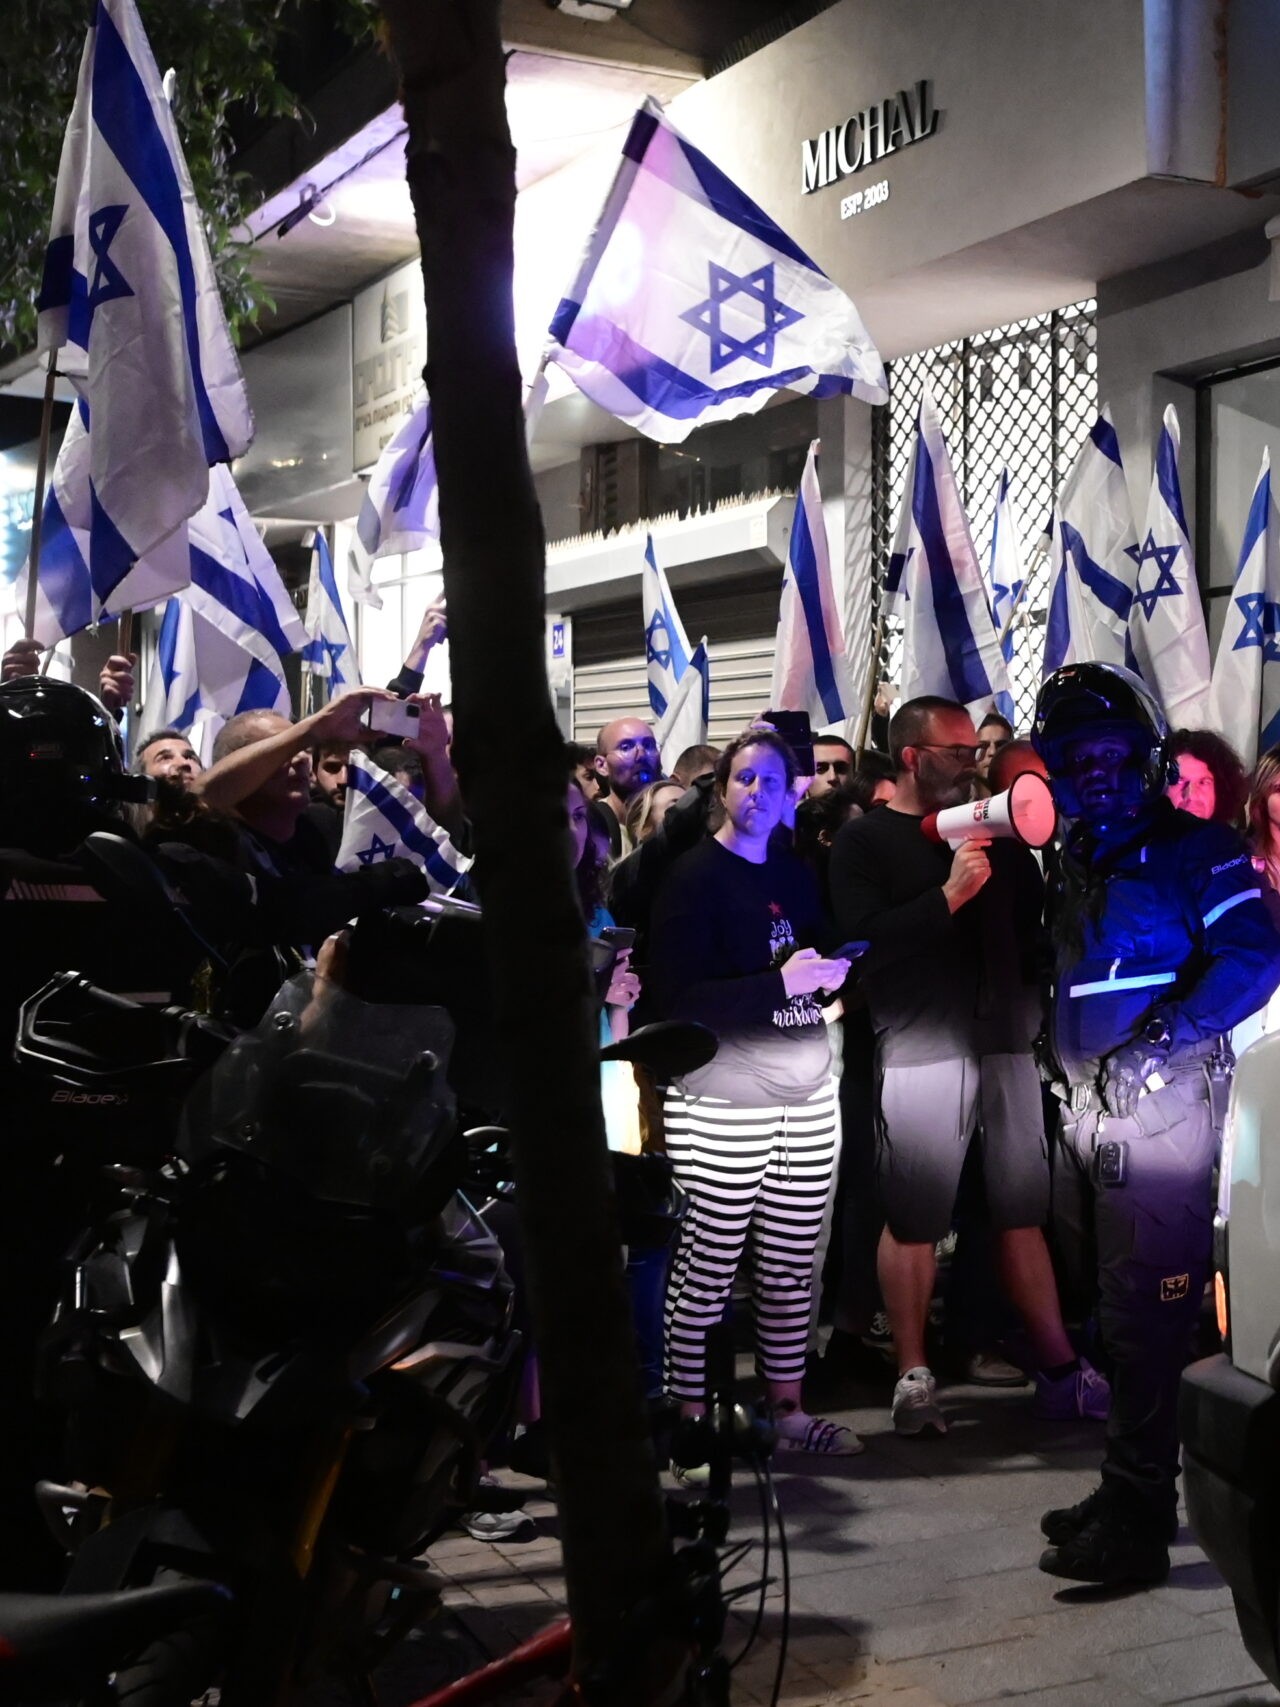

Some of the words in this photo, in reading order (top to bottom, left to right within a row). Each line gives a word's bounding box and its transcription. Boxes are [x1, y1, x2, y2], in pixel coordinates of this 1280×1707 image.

[801, 80, 939, 195] MICHAL
[864, 179, 889, 210] 2003
[553, 629, 563, 651] 24
